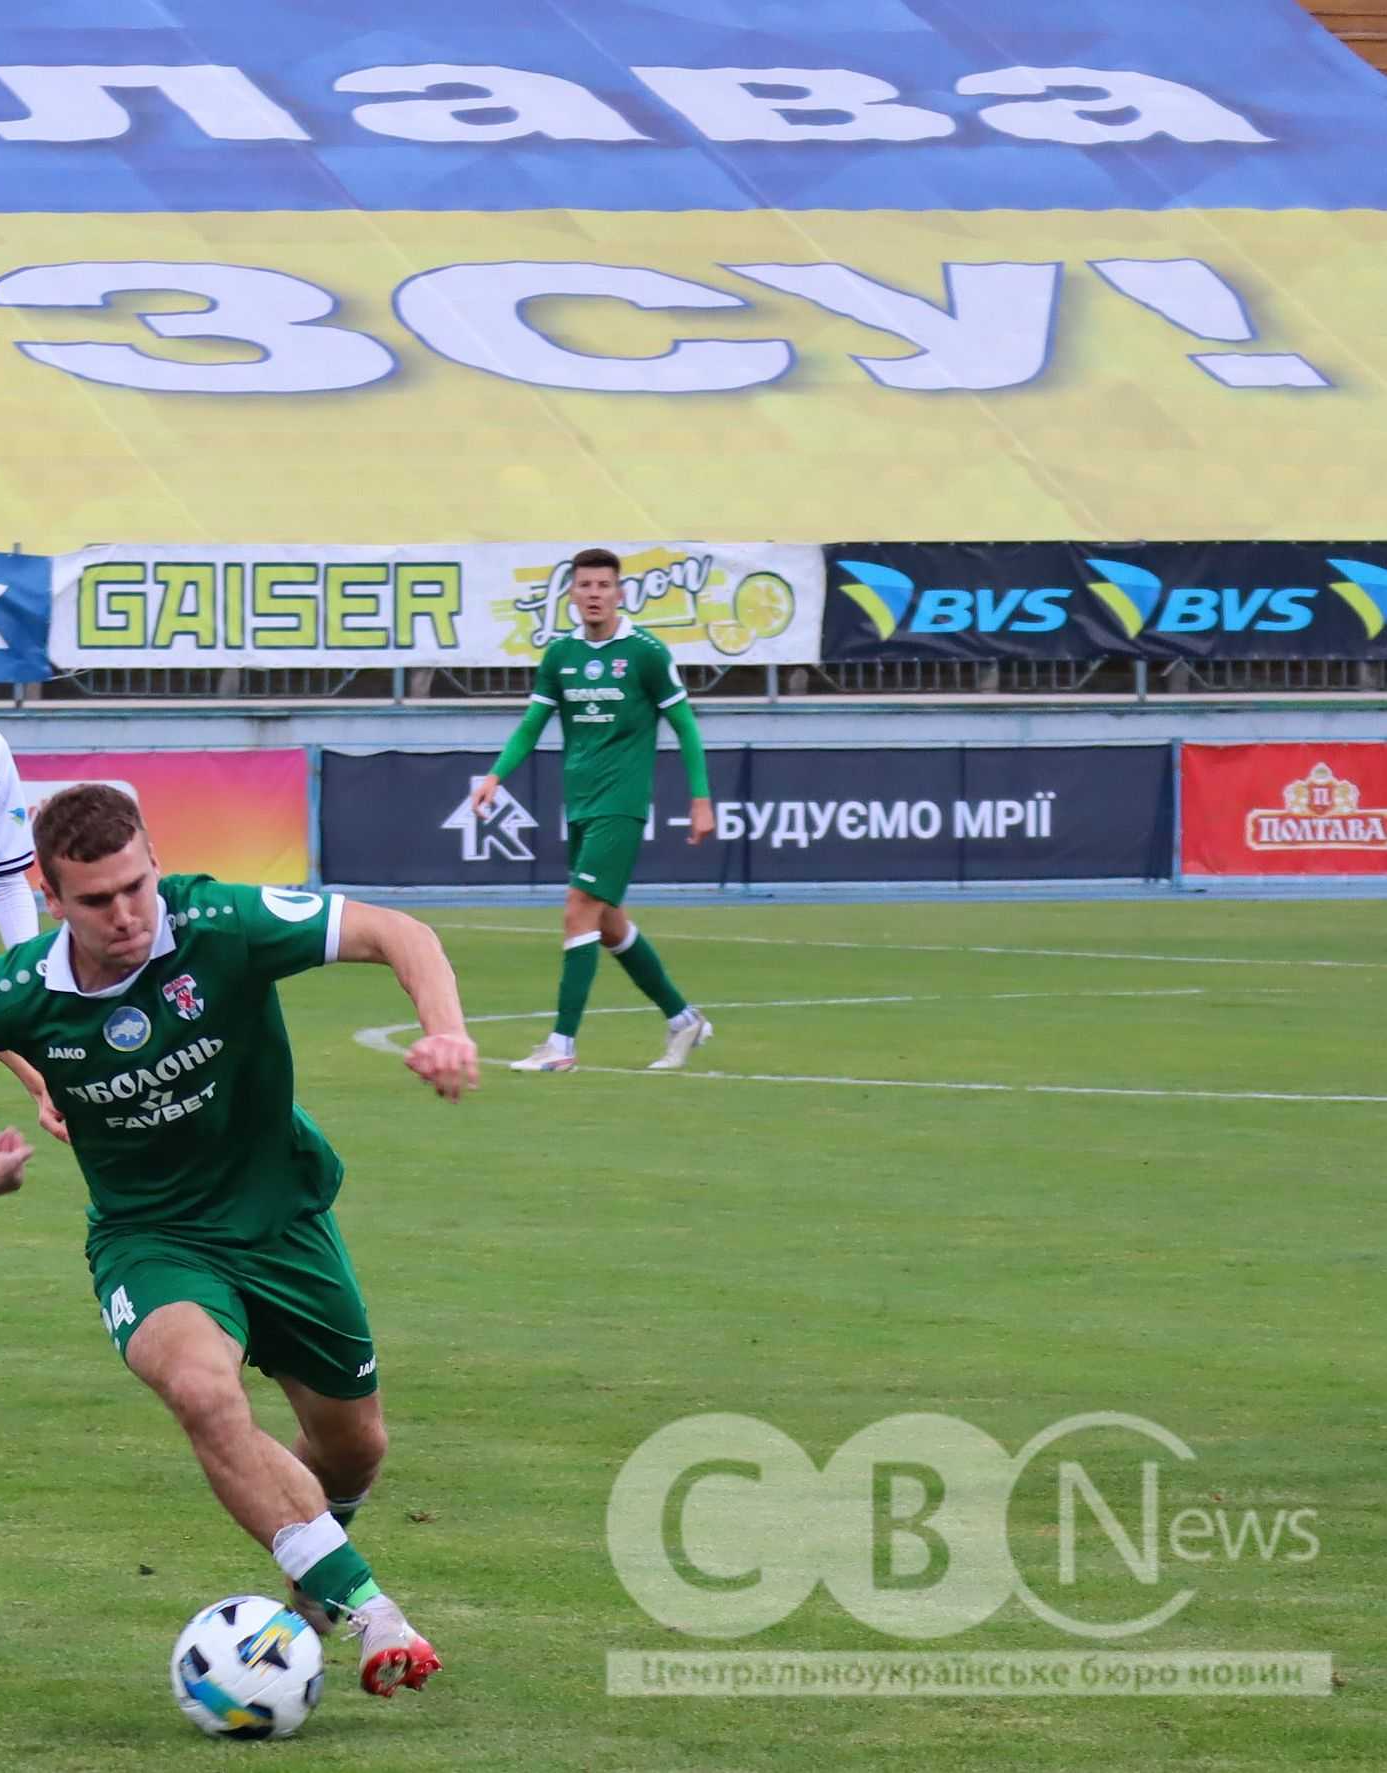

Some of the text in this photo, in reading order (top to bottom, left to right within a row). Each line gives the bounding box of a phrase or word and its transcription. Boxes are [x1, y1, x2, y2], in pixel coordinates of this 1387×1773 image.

[78, 561, 461, 650] GAISER
[514, 554, 713, 648] Lmon
[911, 587, 1073, 633] BVS
[1156, 587, 1319, 633] BVS
[715, 800, 942, 849] БУДУЄМО
[953, 791, 1057, 839] МРІЇ
[1258, 816, 1387, 843] ПОЛТАВА
[46, 1047, 88, 1061] JAKO
[106, 1081, 216, 1129] FAVBET
